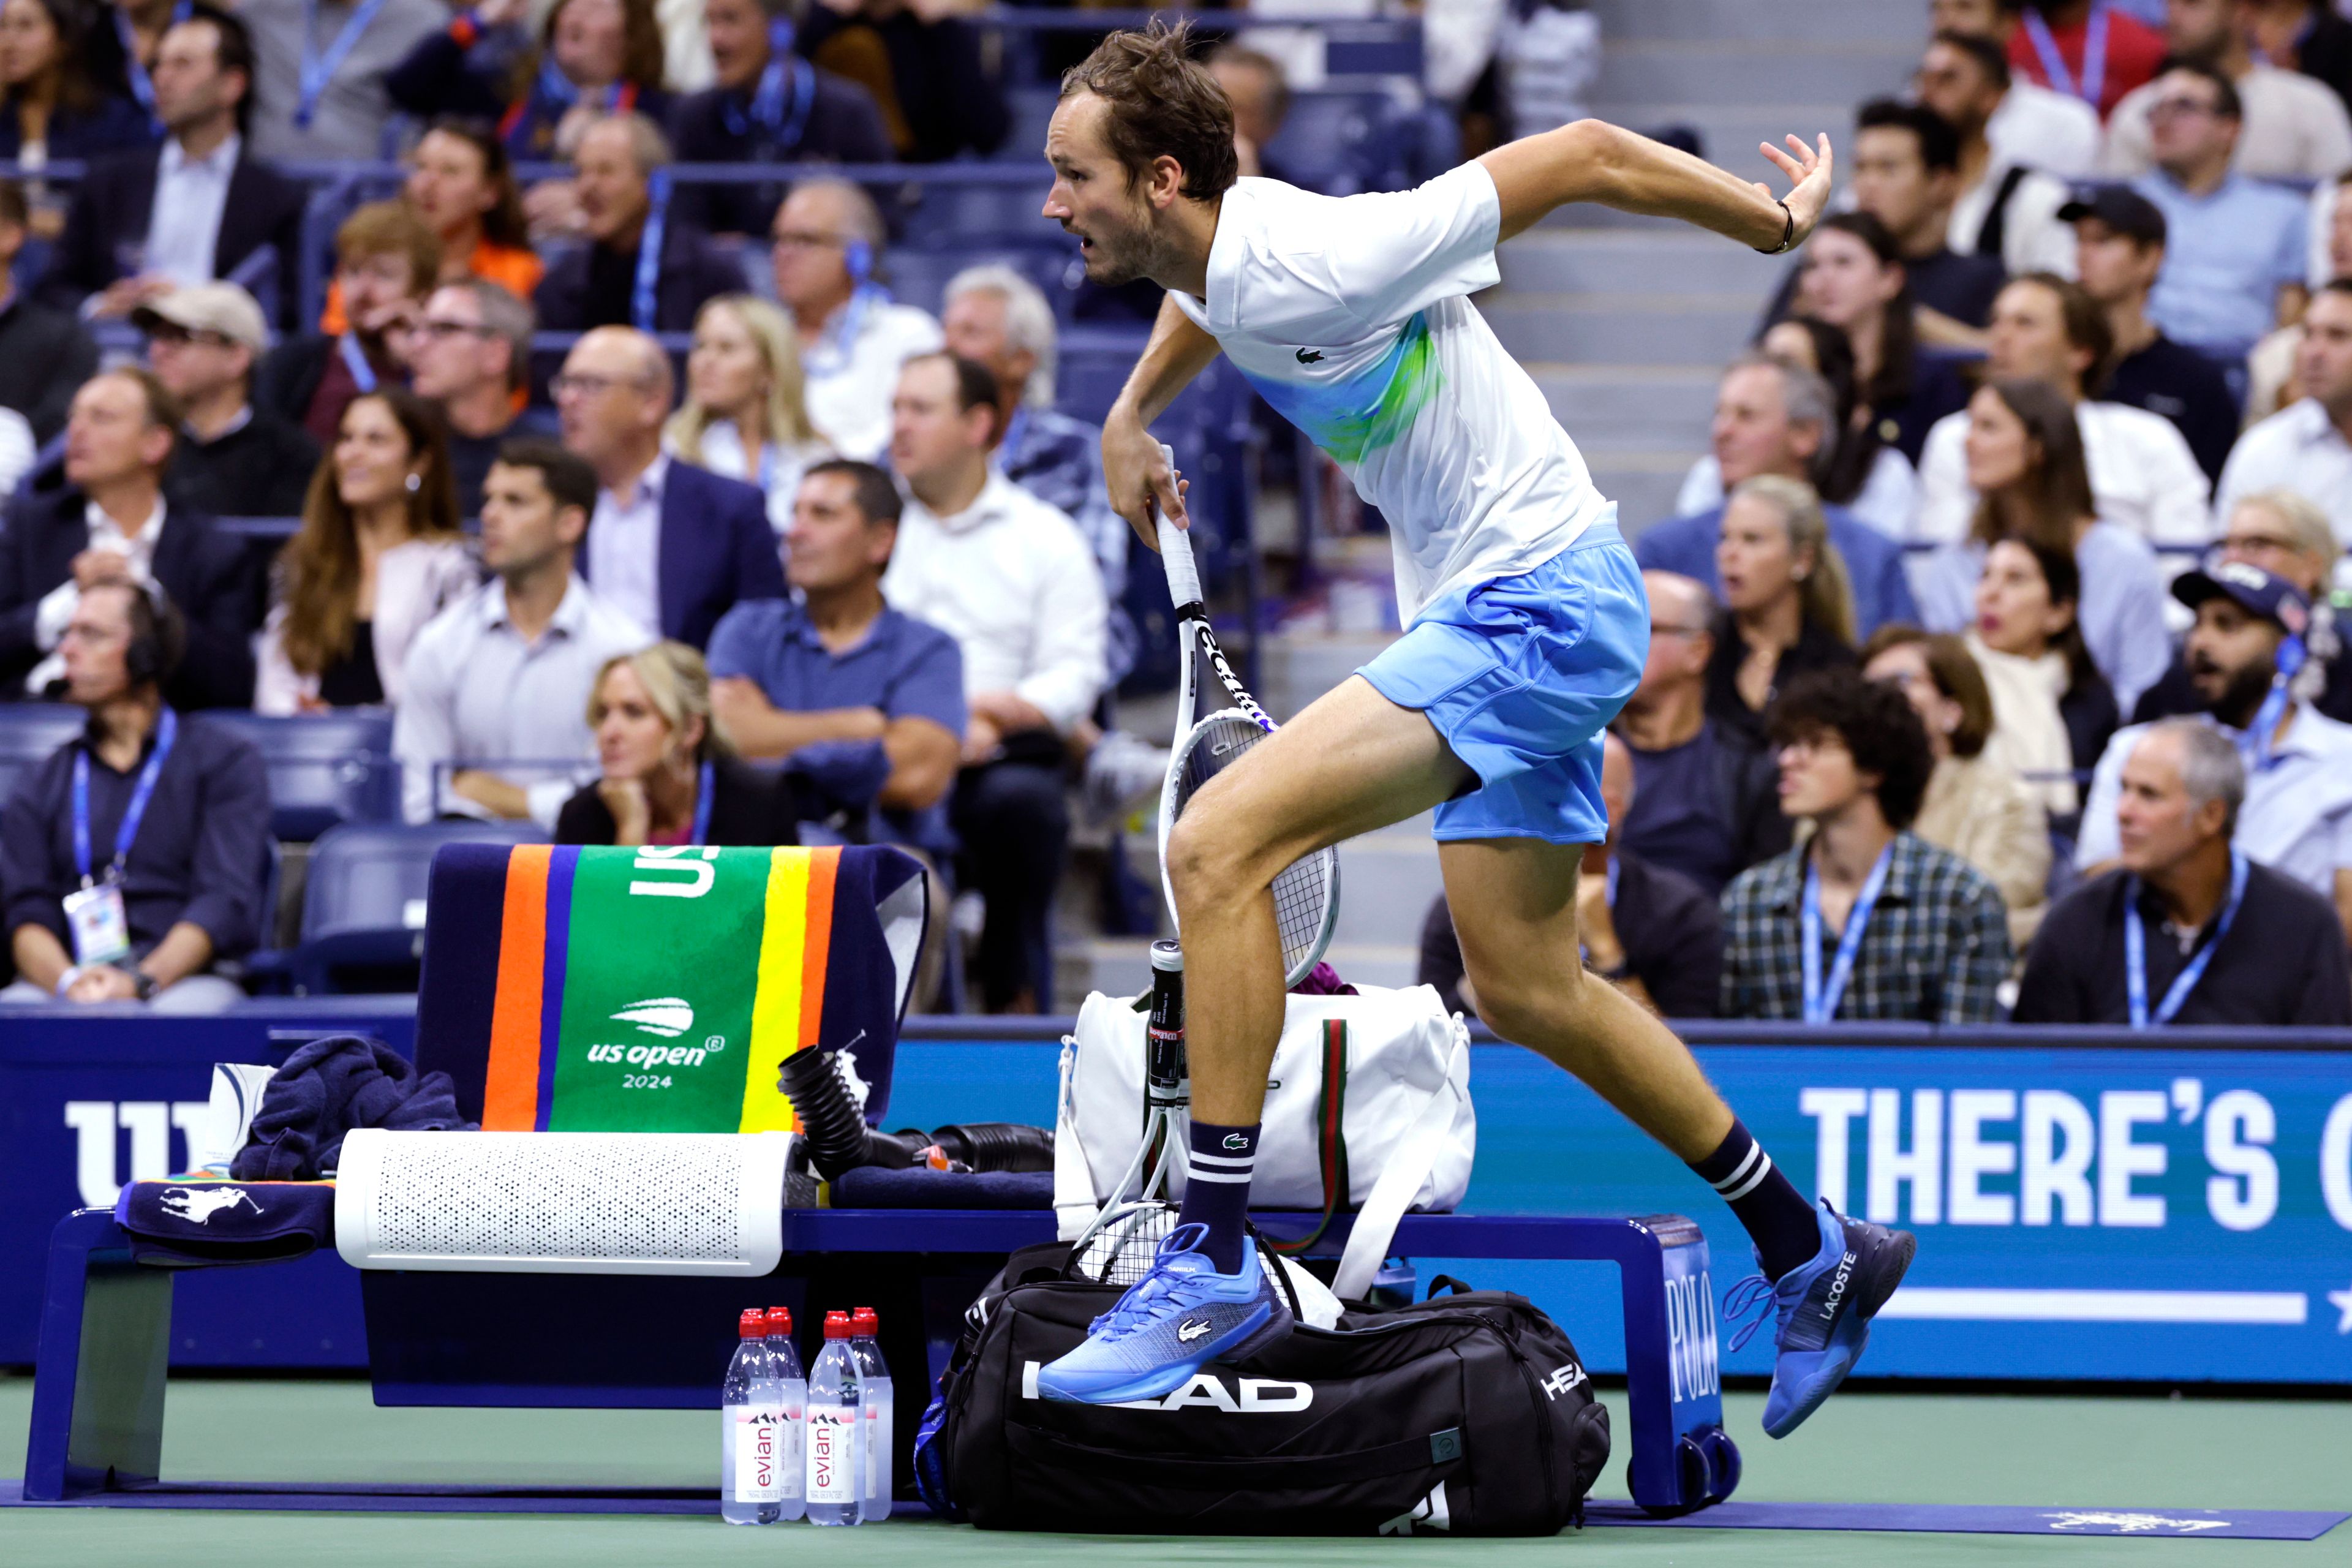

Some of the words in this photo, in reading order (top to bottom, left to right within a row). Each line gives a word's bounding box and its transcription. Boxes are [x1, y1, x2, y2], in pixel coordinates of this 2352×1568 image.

[588, 1044, 625, 1063] us
[622, 1074, 673, 1088] 2024
[1800, 1078, 2279, 1232] THERE'S
[1819, 1251, 1857, 1321] LACOSTE
[1665, 1270, 1717, 1403] POLO
[754, 1428, 771, 1487] evian
[814, 1428, 830, 1487] evian
